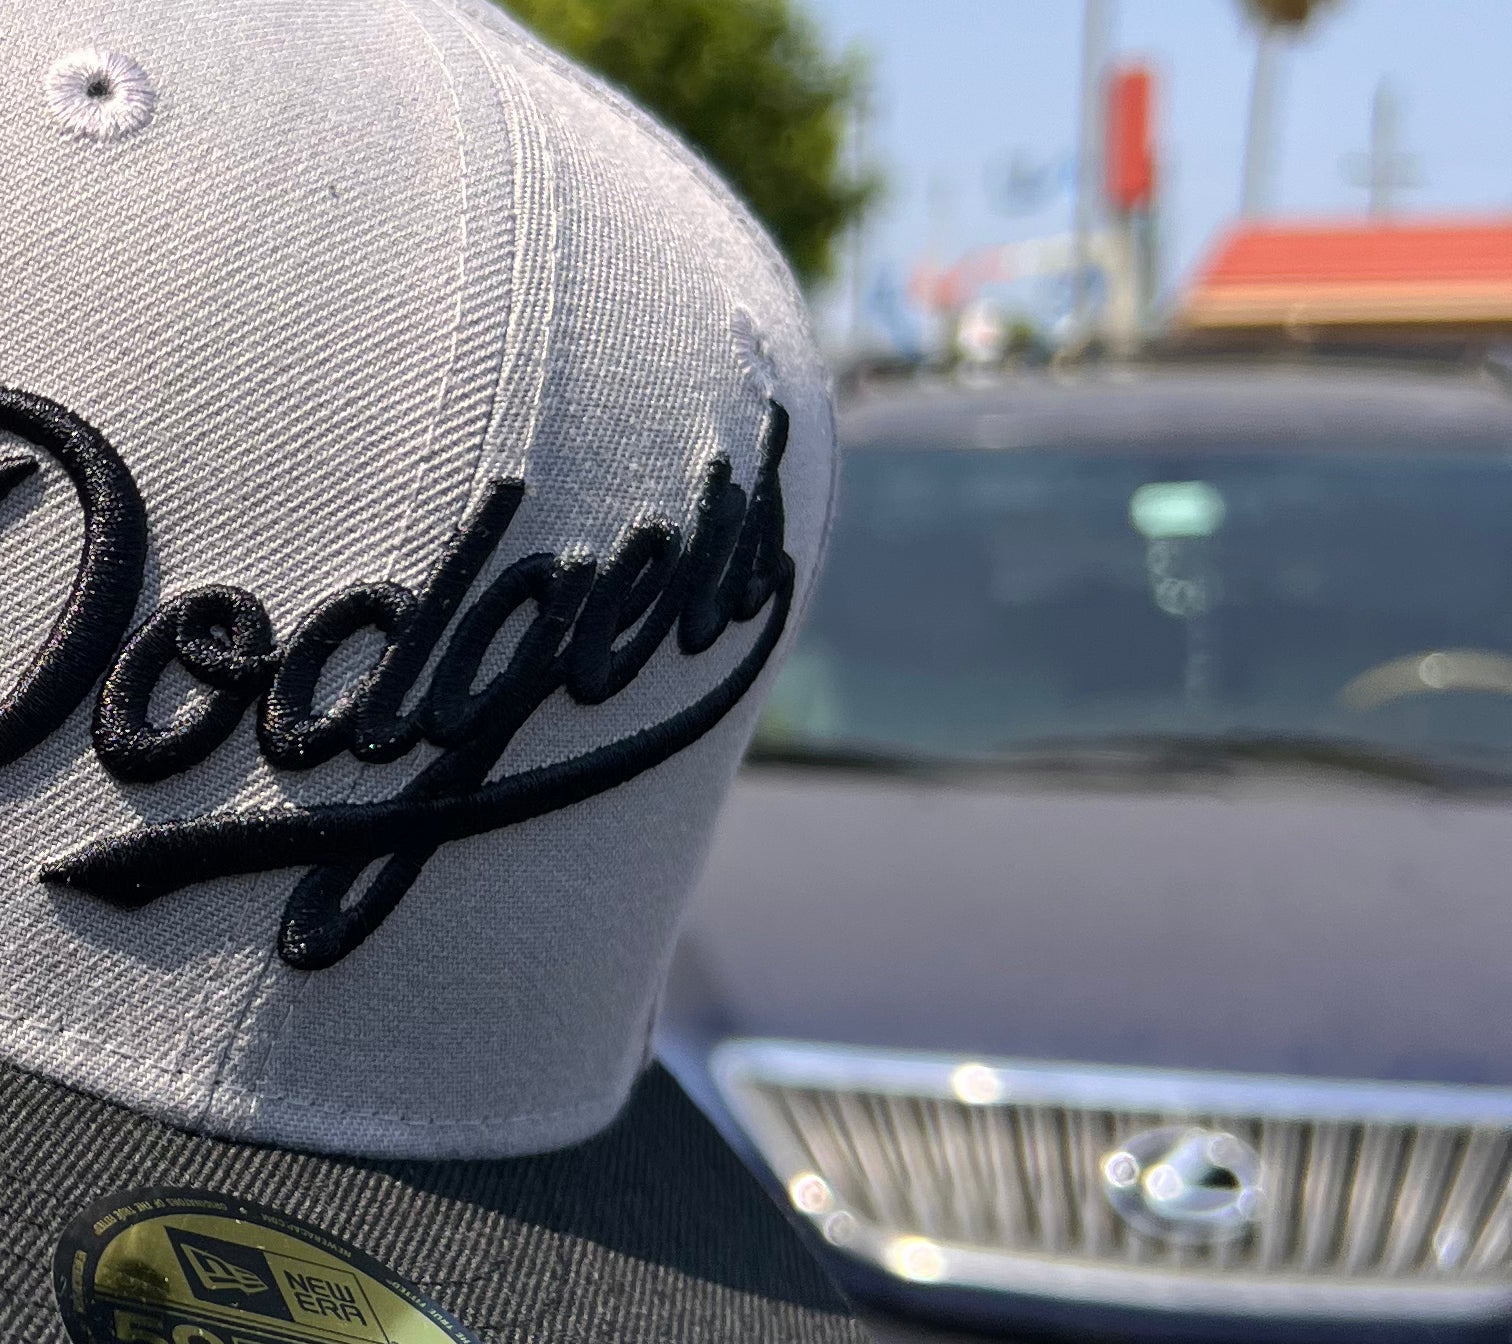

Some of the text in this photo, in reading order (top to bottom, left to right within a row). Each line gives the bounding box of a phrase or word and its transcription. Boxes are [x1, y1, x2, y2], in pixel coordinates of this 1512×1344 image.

[284, 1268, 356, 1305] NEW
[293, 1291, 368, 1328] ERA
[428, 1307, 454, 1331] TRUE
